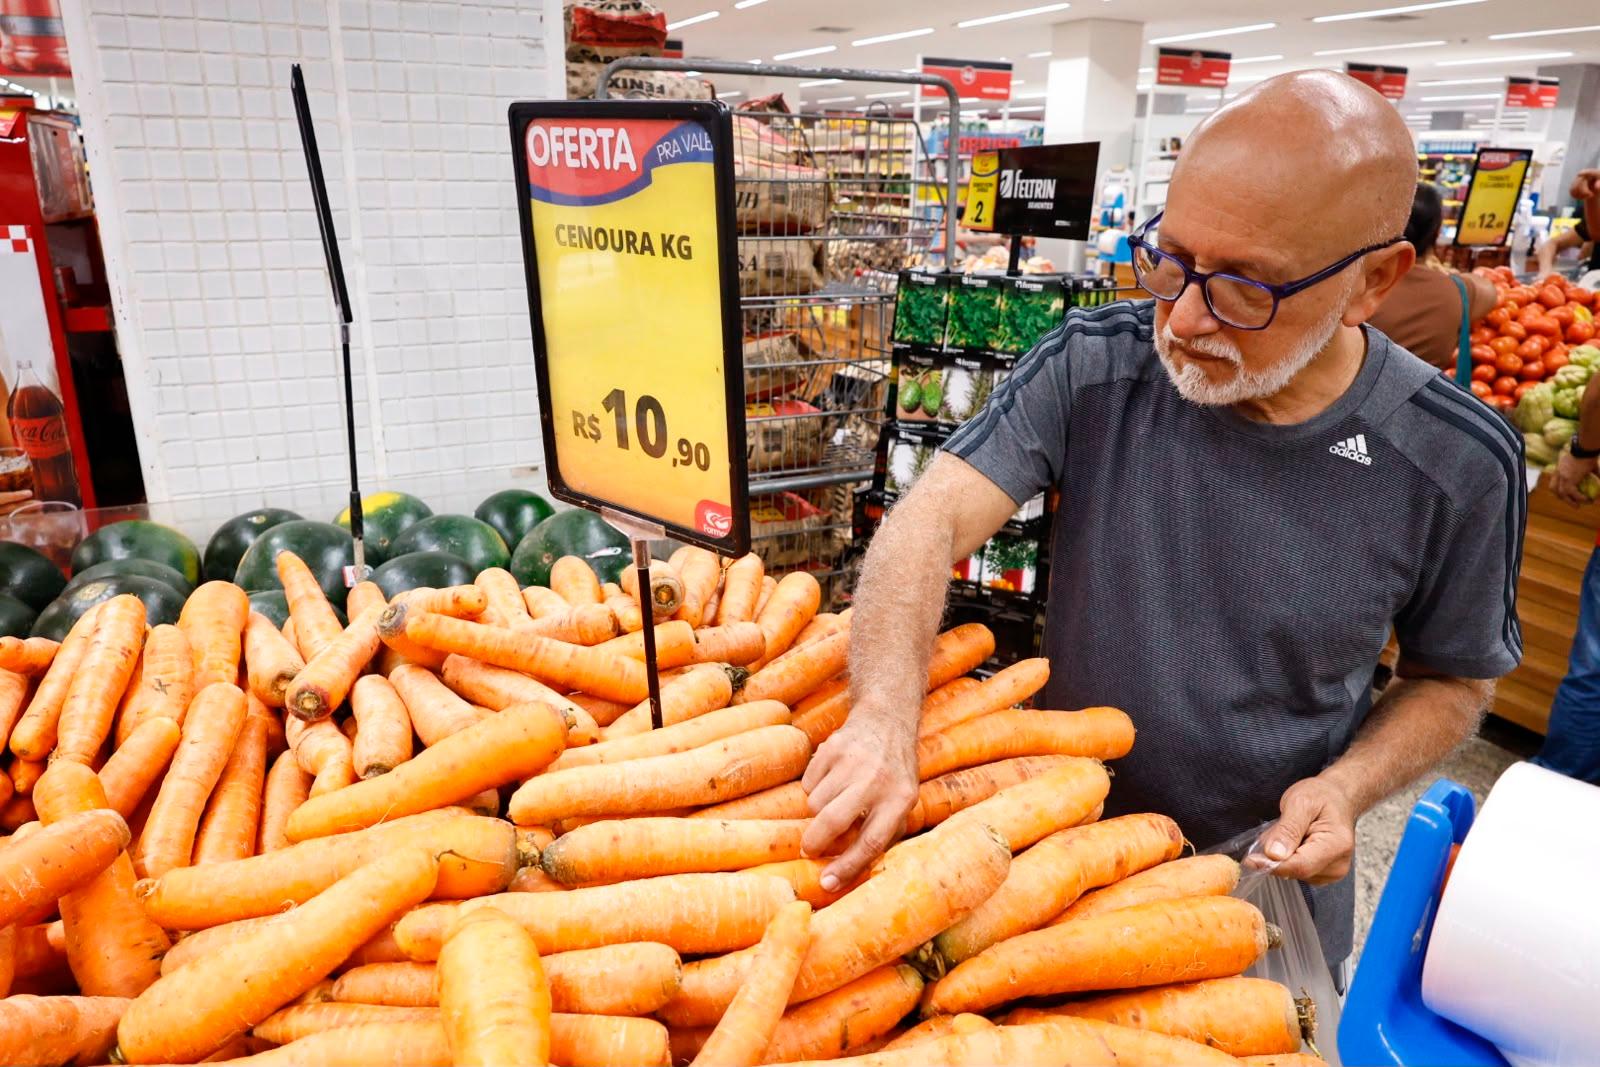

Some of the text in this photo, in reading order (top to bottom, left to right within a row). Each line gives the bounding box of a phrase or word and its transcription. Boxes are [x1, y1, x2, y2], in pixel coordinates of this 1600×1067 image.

[526, 125, 637, 172] OFERTA
[656, 138, 682, 163] PRA
[974, 201, 984, 223] 2
[555, 223, 692, 260] CENOURA KG
[1328, 445, 1373, 466] adidas
